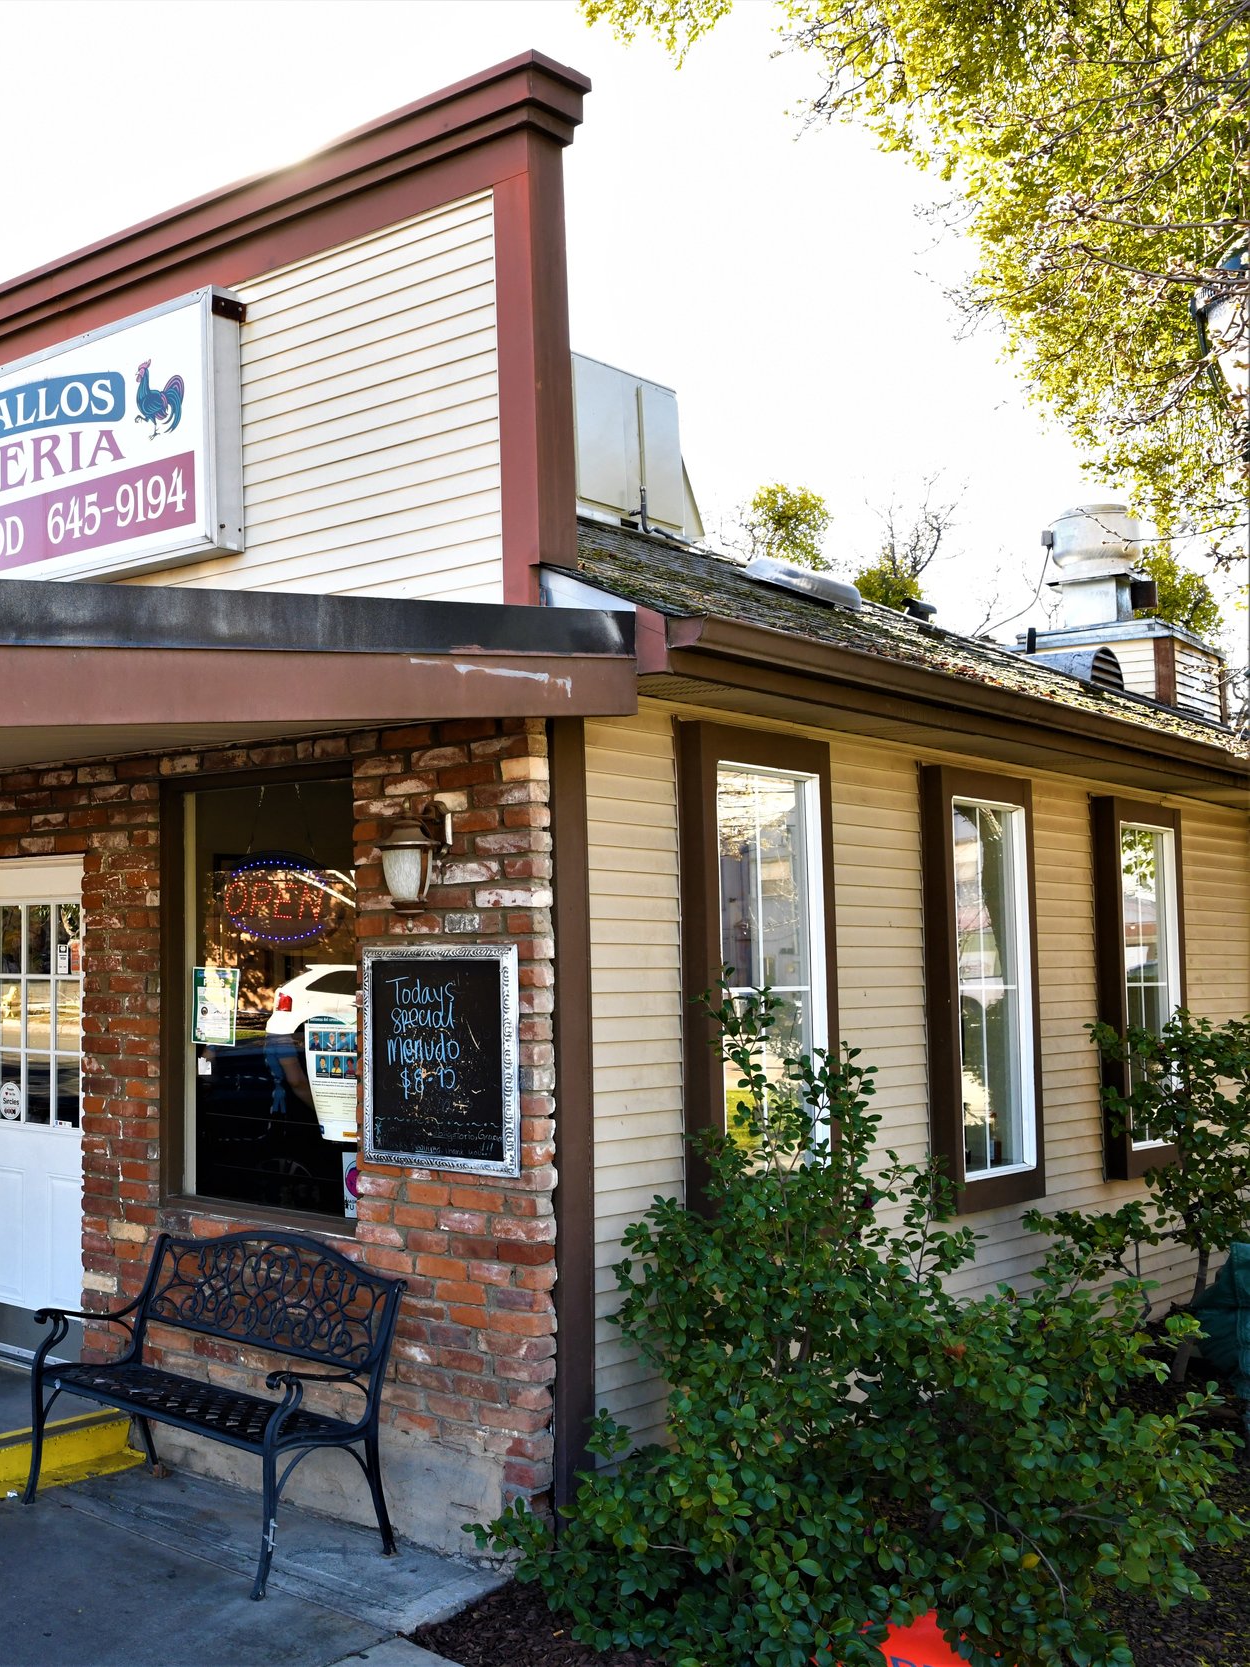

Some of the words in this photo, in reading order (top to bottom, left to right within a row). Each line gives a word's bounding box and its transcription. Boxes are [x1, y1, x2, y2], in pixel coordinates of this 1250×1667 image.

[47, 465, 188, 545] 645-9194
[224, 881, 325, 921] OPEN
[385, 976, 456, 1007] Todays
